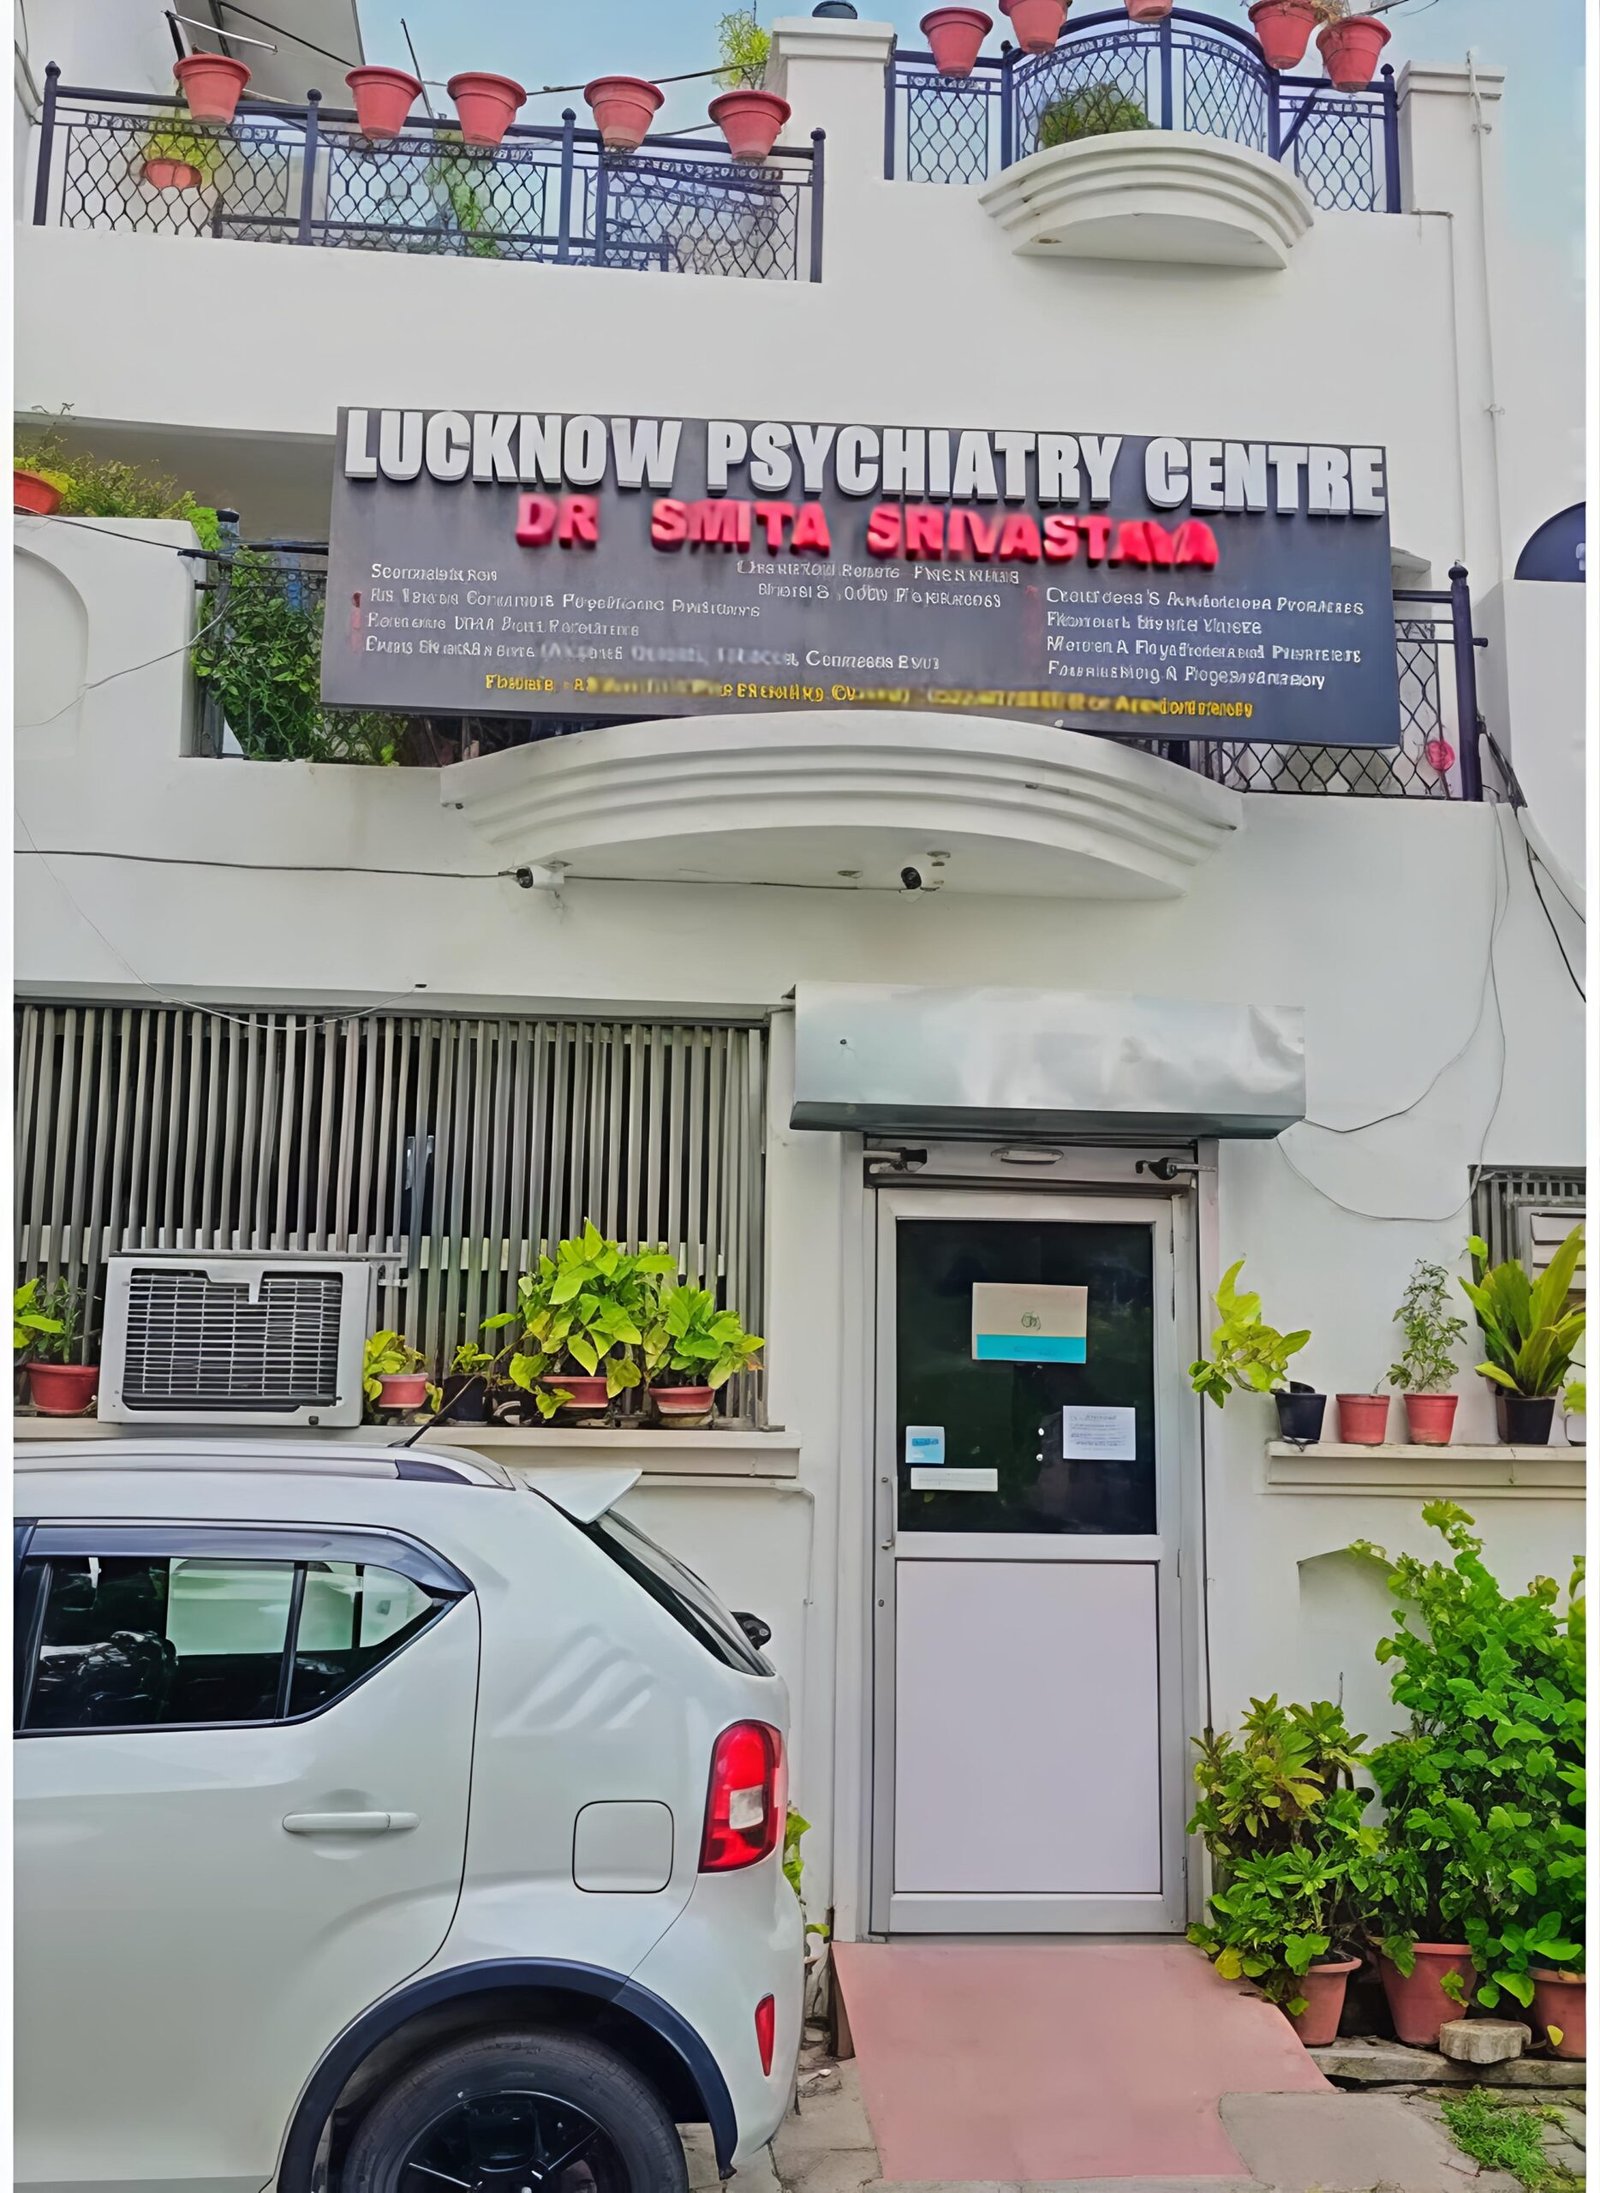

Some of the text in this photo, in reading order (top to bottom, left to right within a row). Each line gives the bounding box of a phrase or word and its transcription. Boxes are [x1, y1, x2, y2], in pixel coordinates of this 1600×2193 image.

[344, 409, 1386, 517] LUCKNOW PSYCHIATRY CENTRE
[515, 493, 601, 549] DR
[650, 498, 832, 558] SMITA
